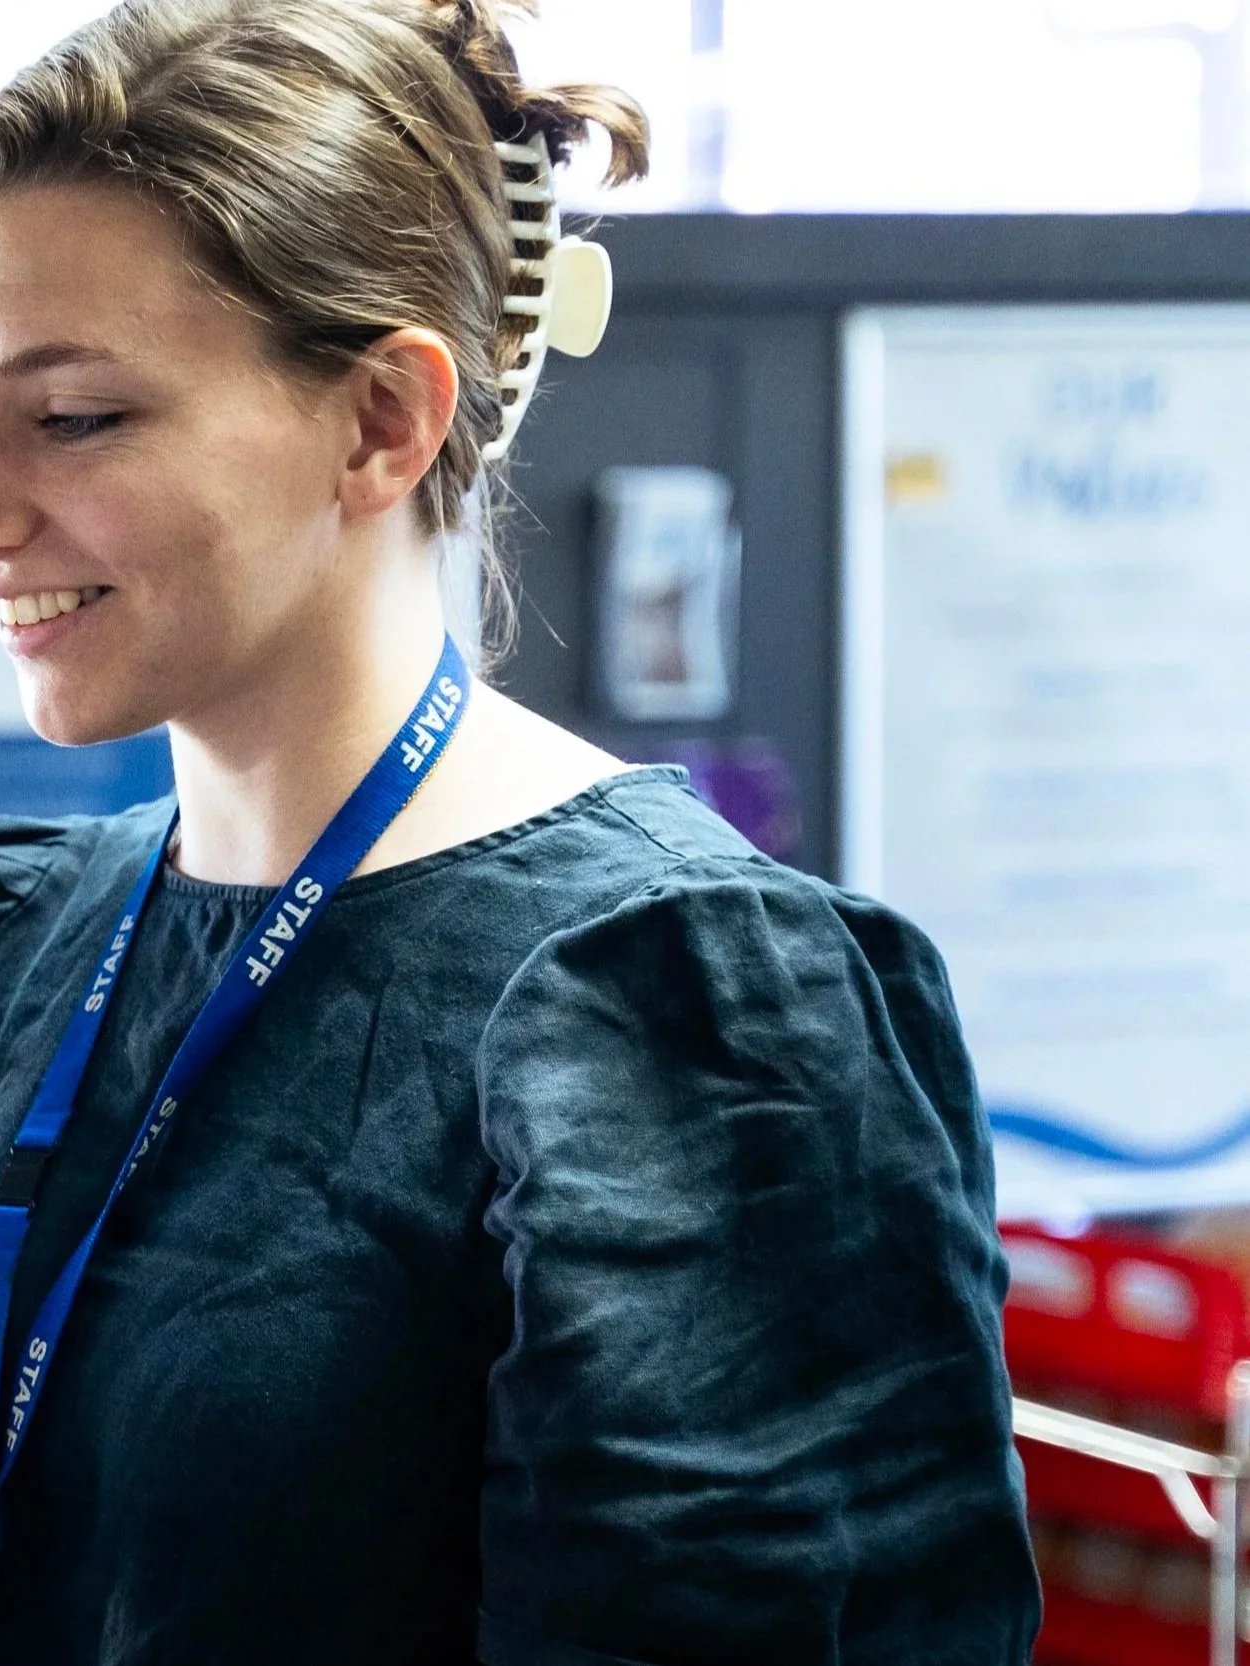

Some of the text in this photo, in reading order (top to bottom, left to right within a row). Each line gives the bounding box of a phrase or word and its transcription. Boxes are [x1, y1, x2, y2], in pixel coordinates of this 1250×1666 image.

[399, 676, 462, 773] STAFF
[84, 914, 134, 1012] STAFF
[246, 876, 323, 987] STAFF
[119, 1096, 178, 1191] STA
[7, 1337, 47, 1452] STAFF
